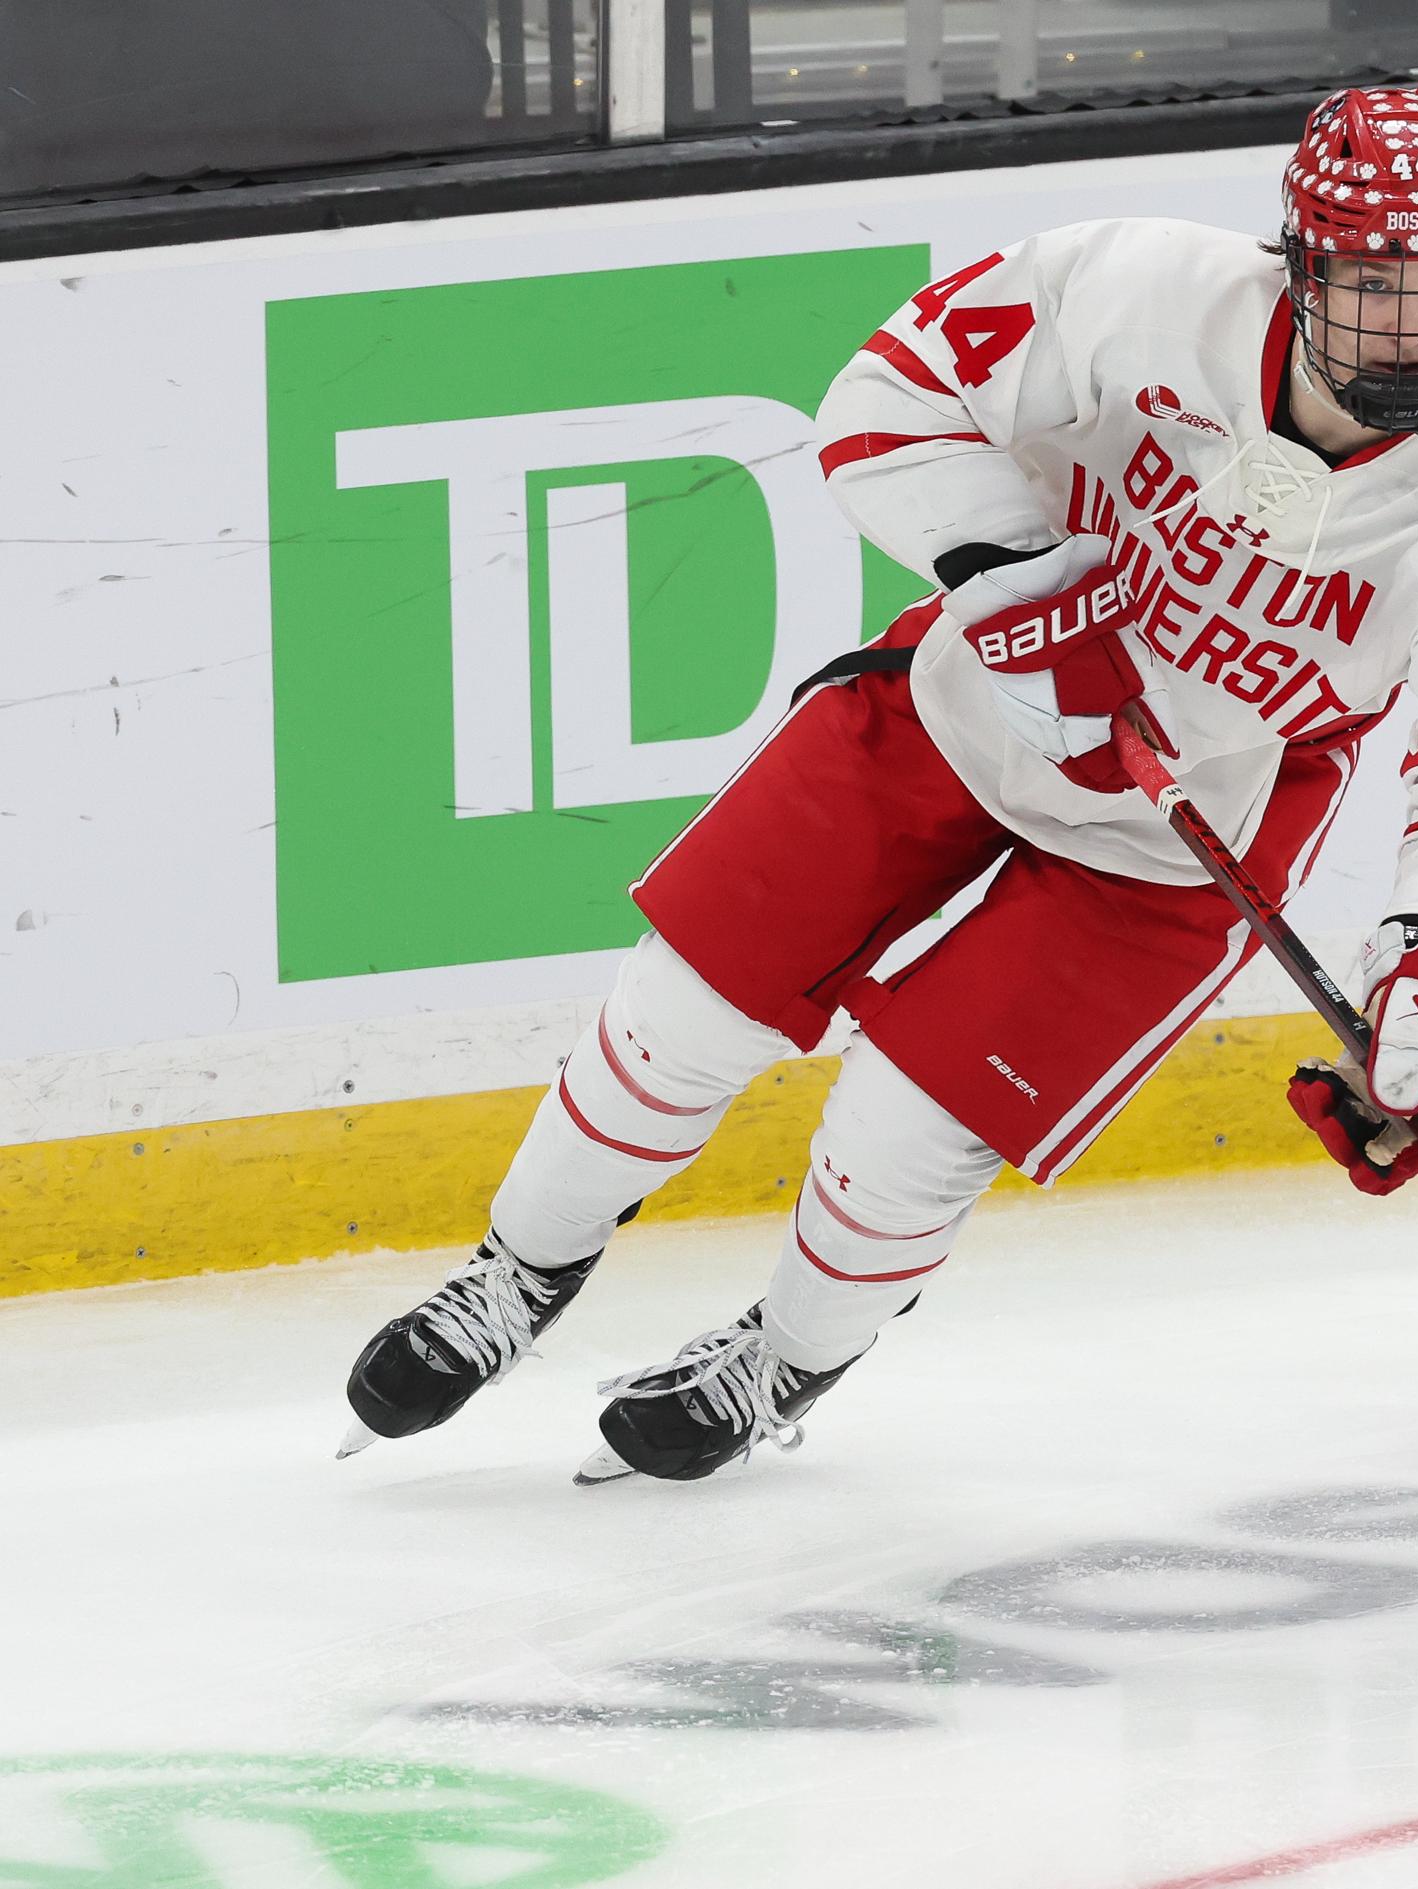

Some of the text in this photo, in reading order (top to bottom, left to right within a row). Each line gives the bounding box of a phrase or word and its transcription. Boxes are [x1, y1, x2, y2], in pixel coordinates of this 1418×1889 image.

[911, 252, 1036, 389] 44
[335, 394, 863, 819] TD
[1066, 462, 1352, 739] UNIVERSIT
[1123, 431, 1376, 646] BOSTON
[1312, 969, 1345, 1003] HUTSON 44
